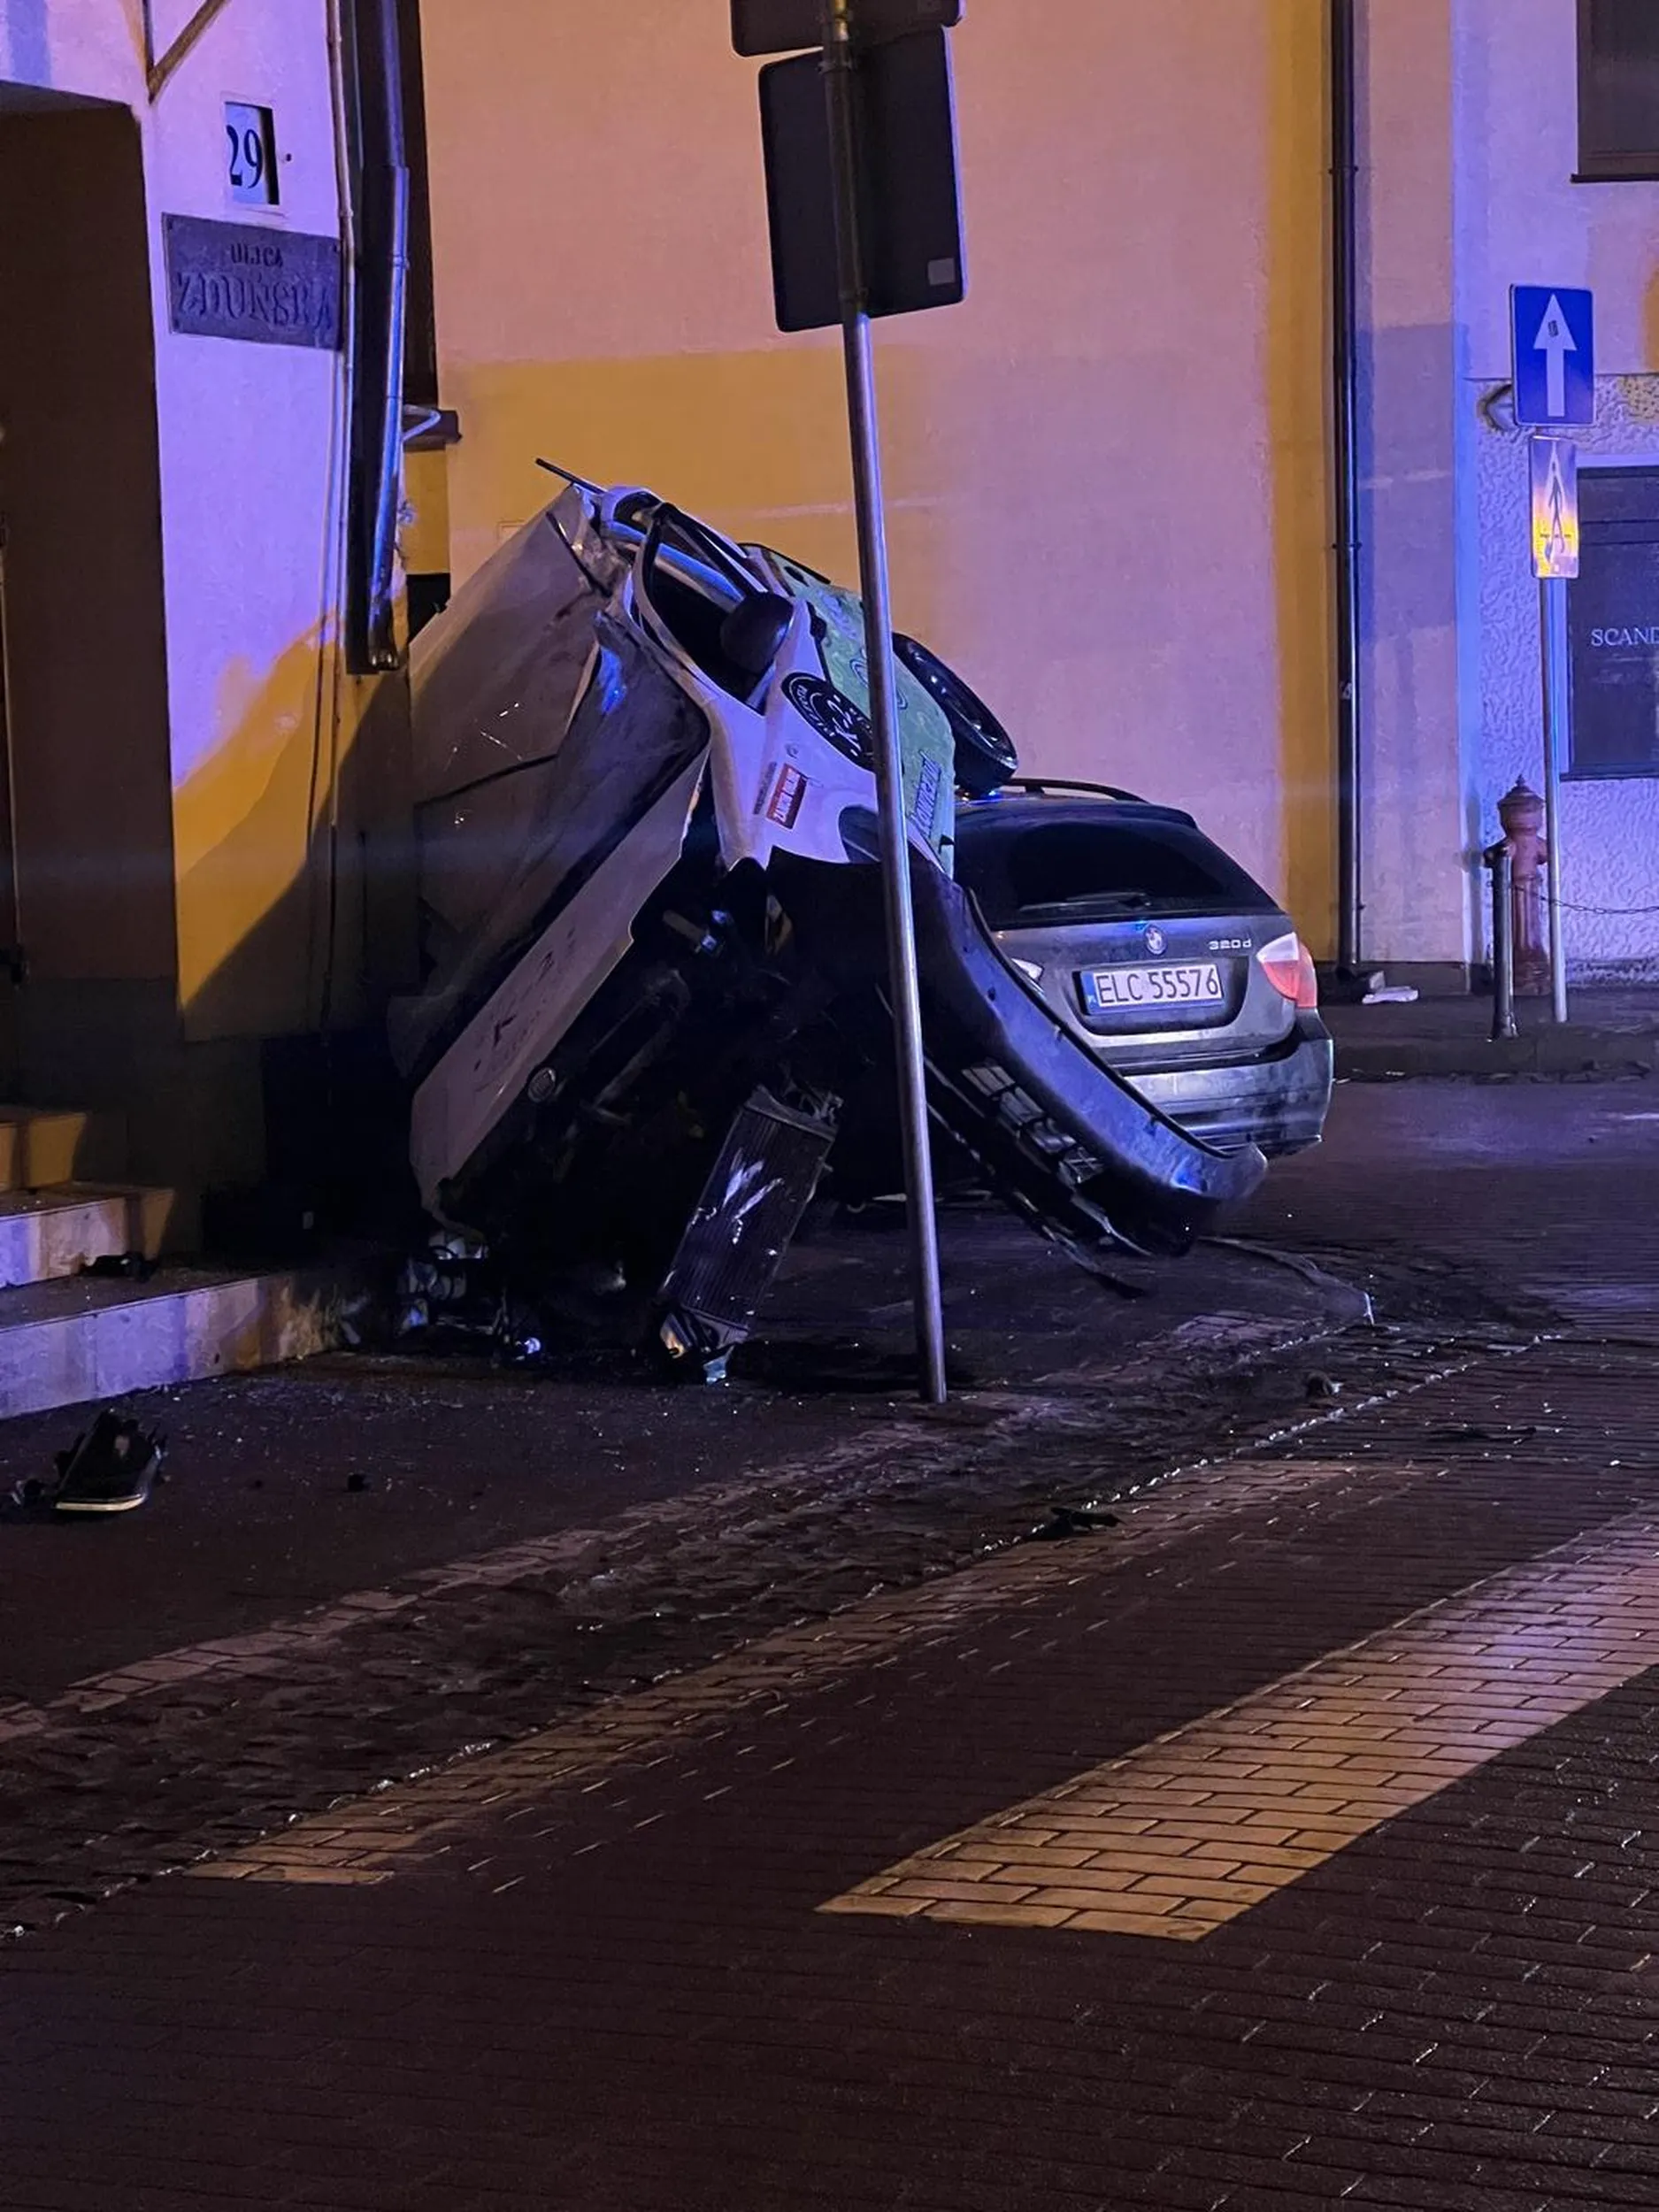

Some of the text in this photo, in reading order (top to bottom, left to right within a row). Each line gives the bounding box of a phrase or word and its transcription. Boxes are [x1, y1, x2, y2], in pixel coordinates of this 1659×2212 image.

[226, 125, 263, 188] 29
[1208, 938, 1252, 950] 320d
[1095, 973, 1143, 1004] ELC
[1148, 967, 1219, 999] 55576
